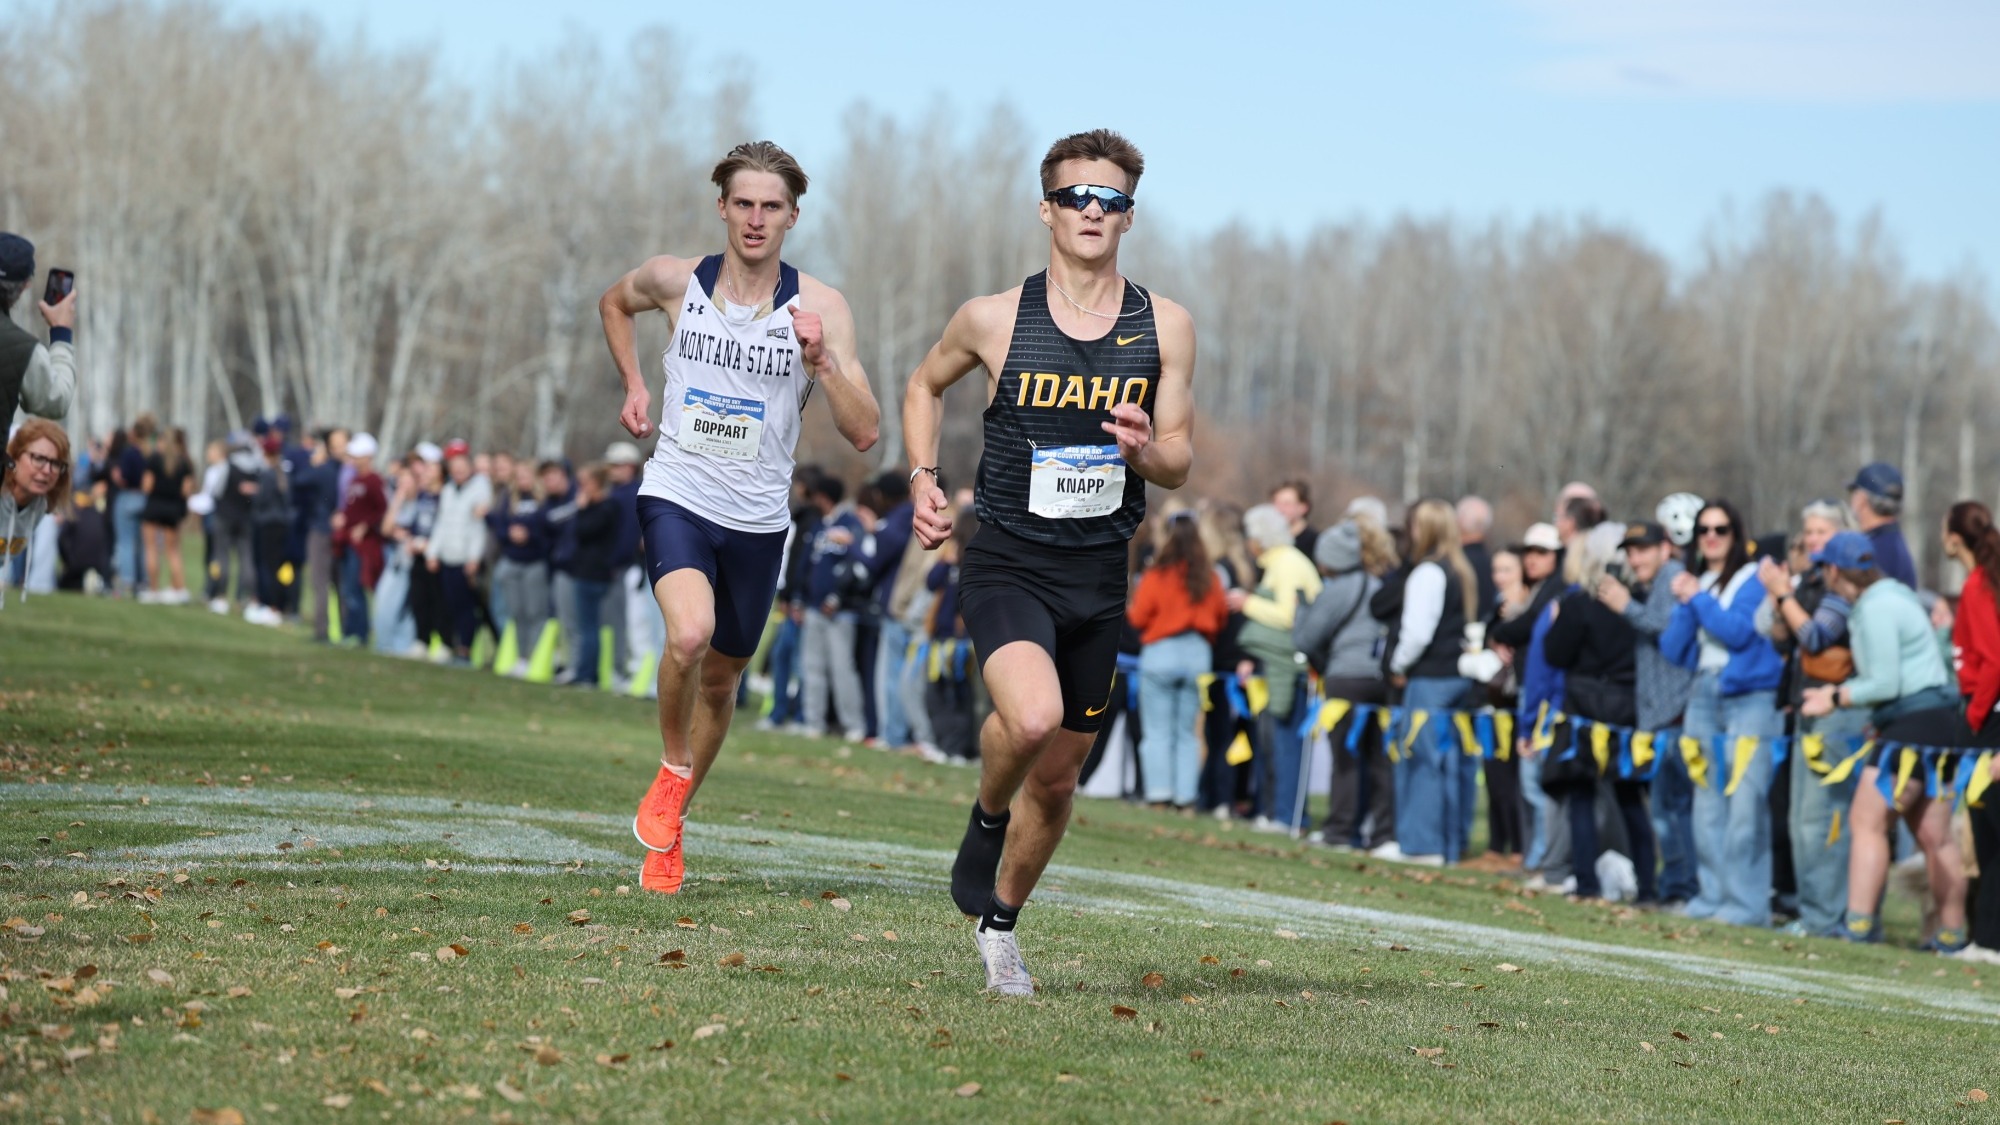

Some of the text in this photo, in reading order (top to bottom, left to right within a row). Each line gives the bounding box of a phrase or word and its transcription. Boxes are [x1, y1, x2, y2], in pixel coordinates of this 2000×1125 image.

[678, 329, 793, 377] MONTANA STATE
[1017, 372, 1149, 411] IDAHO
[703, 398, 725, 408] COUNTRY
[725, 402, 763, 413] CHAMPIONSHIP
[693, 418, 749, 439] BOPPART
[1037, 450, 1057, 458] CROSS
[1057, 452, 1085, 460] COUNTRY
[1056, 477, 1105, 494] KNAPP
